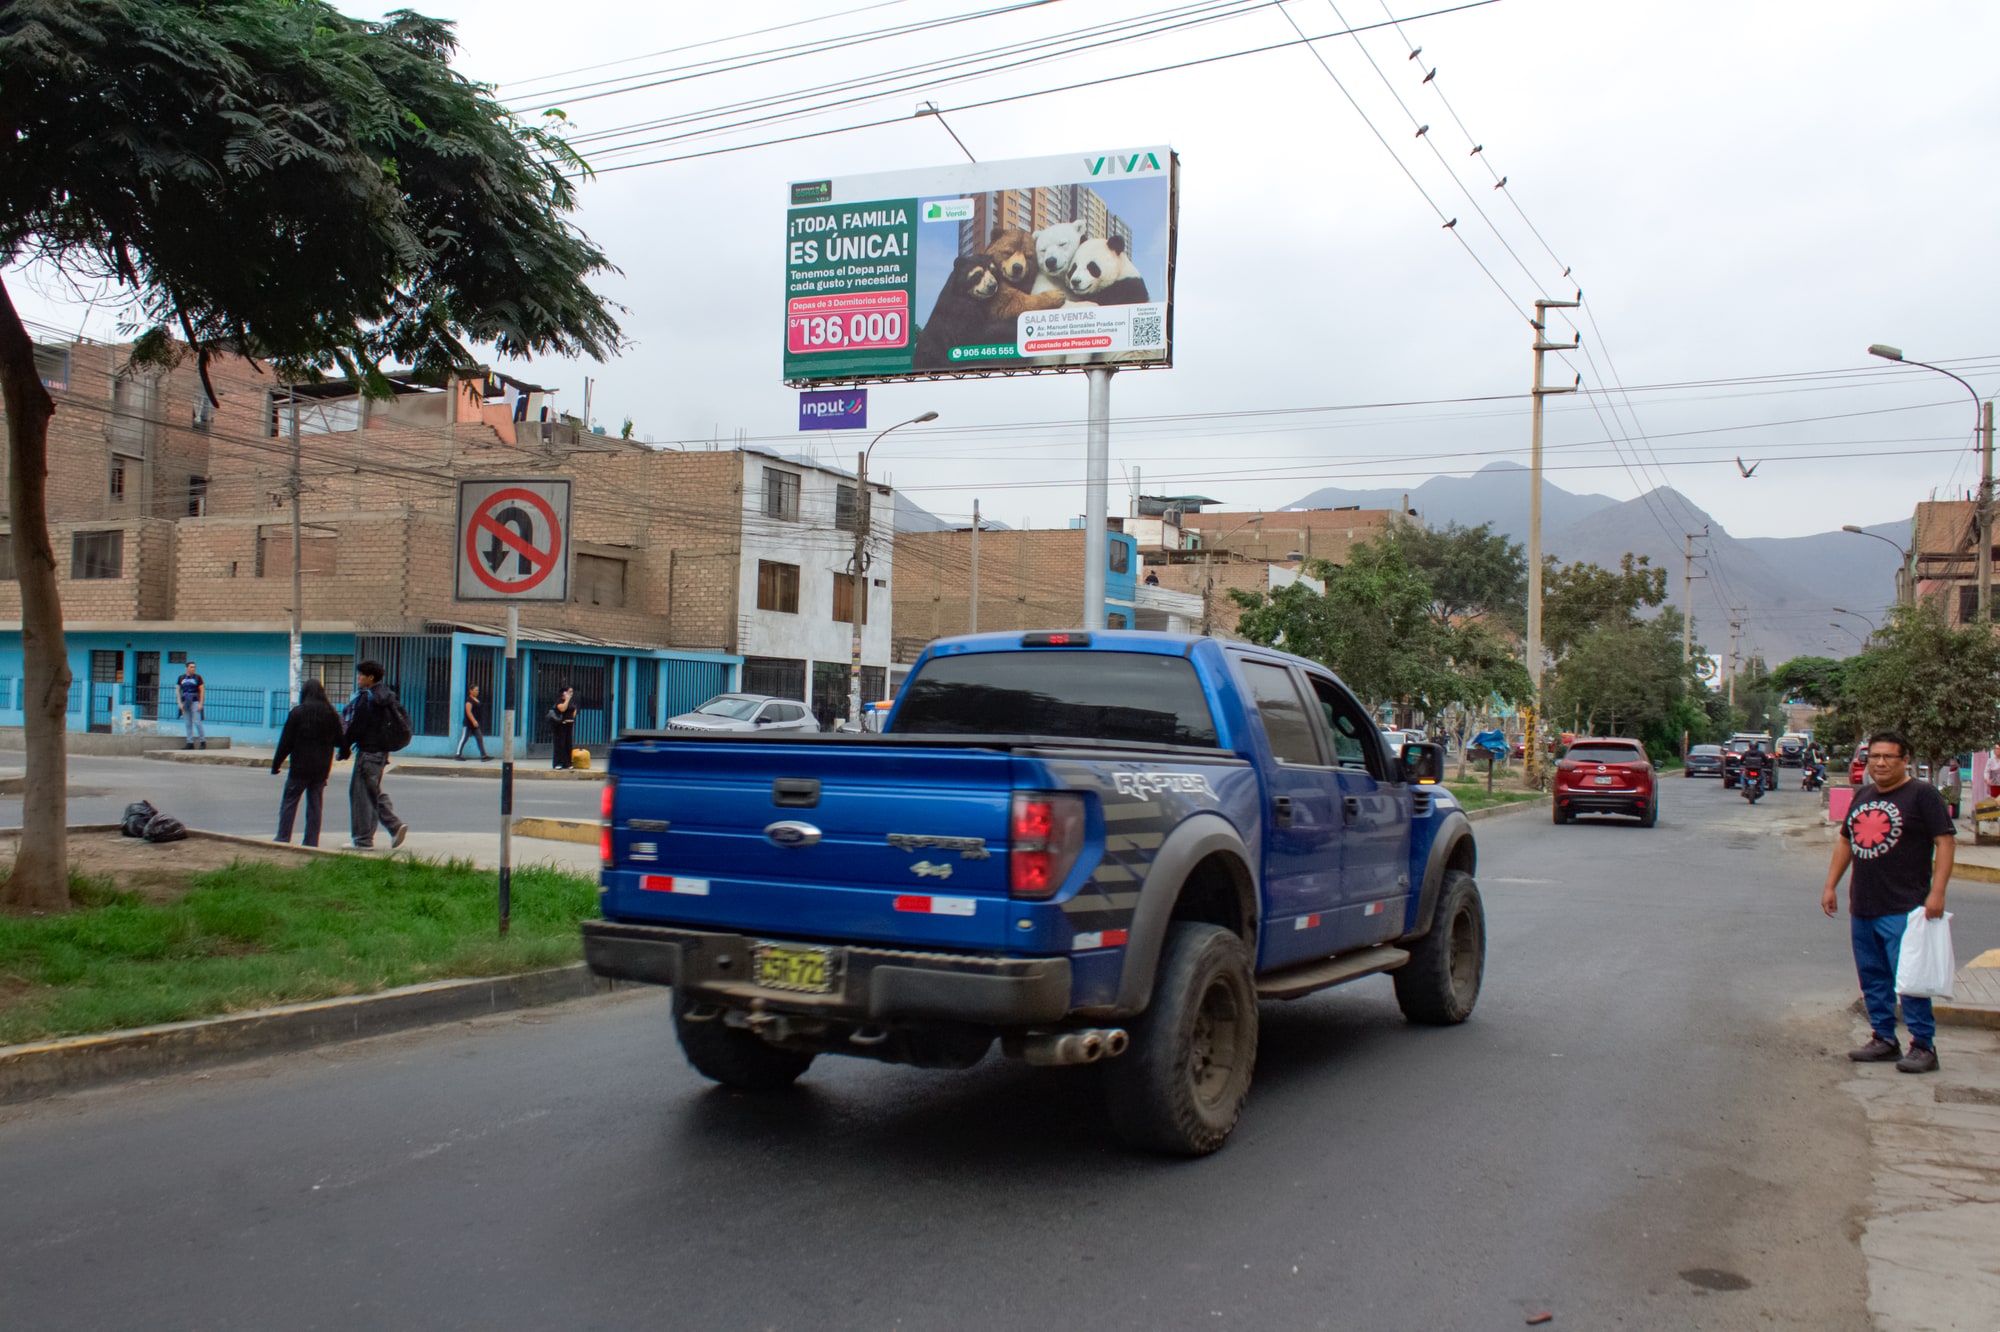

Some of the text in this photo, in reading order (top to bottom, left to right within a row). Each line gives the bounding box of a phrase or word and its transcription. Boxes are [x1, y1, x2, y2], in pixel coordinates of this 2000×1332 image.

[1084, 153, 1160, 175] VIVA
[790, 209, 908, 238] ¡TODA FAMILIA
[790, 232, 909, 265] ES ÚNICA!
[790, 263, 900, 280] Tenemos el Depa para
[790, 273, 908, 292] cada gusto y necesidad
[793, 294, 902, 311] Depas de 3 Dormitorios desde:
[1024, 311, 1096, 324] SALA DE VENTAS:
[1047, 323, 1068, 331] Manuel
[1096, 320, 1114, 328] Prada
[1047, 329, 1069, 337] Micaela
[1097, 326, 1118, 334] Comas
[1036, 341, 1062, 349] costado
[1091, 338, 1109, 346] UNO!
[802, 399, 845, 417] input
[1112, 772, 1221, 802] RAPTOR
